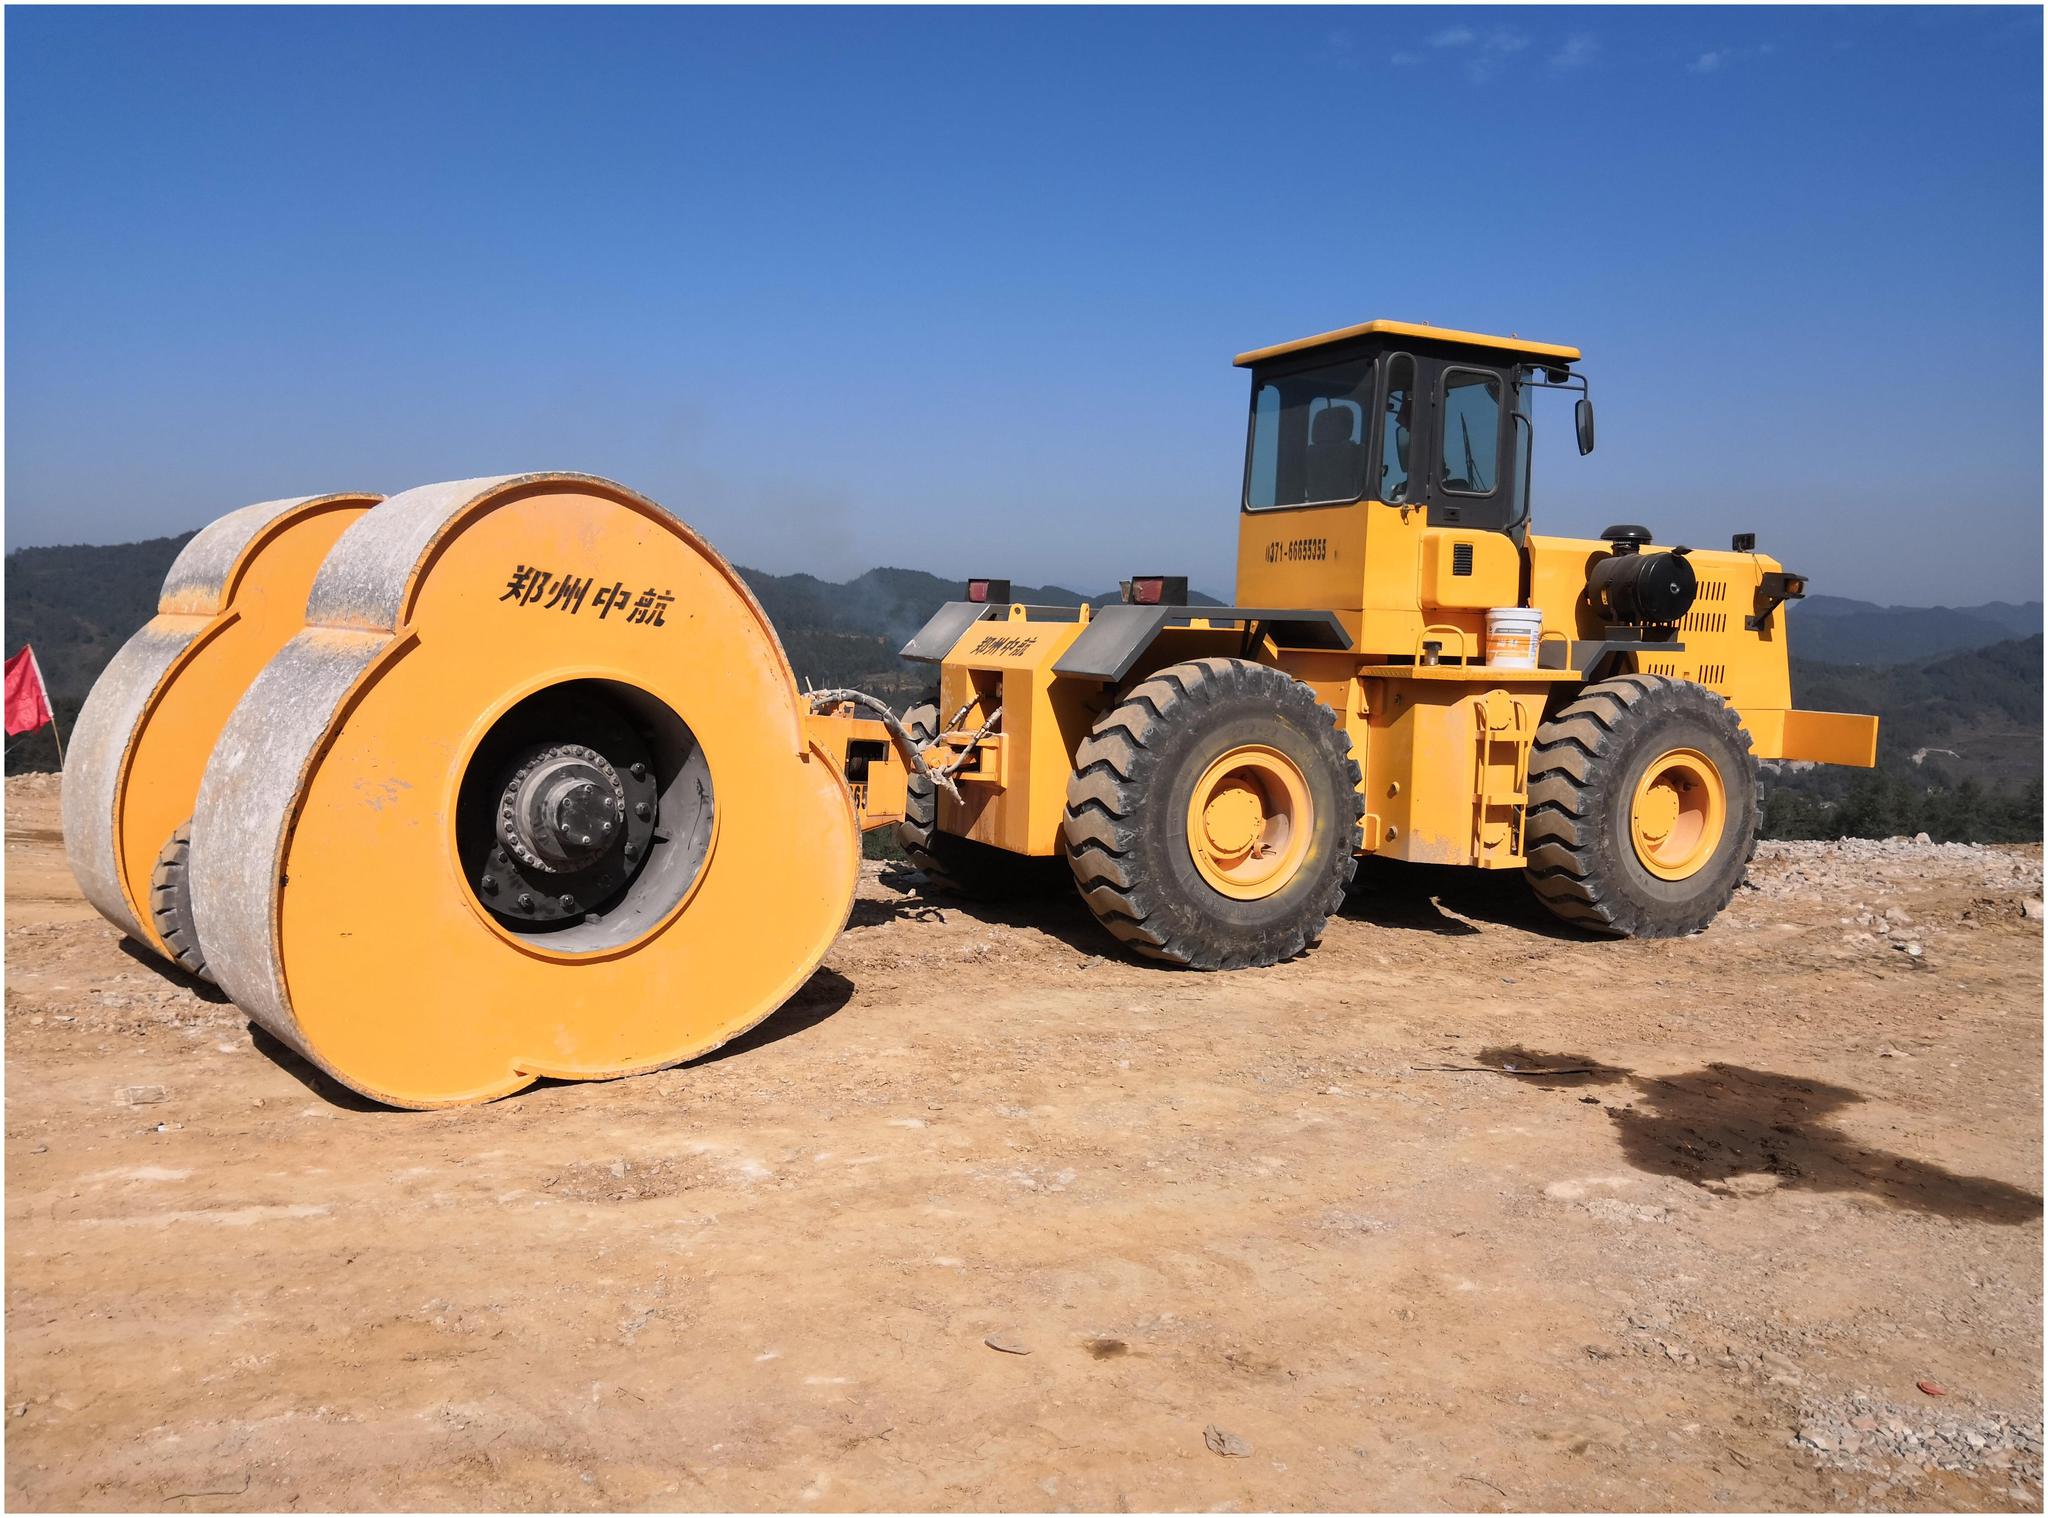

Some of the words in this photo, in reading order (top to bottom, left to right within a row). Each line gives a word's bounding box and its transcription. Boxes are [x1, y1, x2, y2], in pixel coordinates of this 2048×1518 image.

[498, 565, 675, 627] 郑州中航
[970, 636, 1037, 656] 郑州中航
